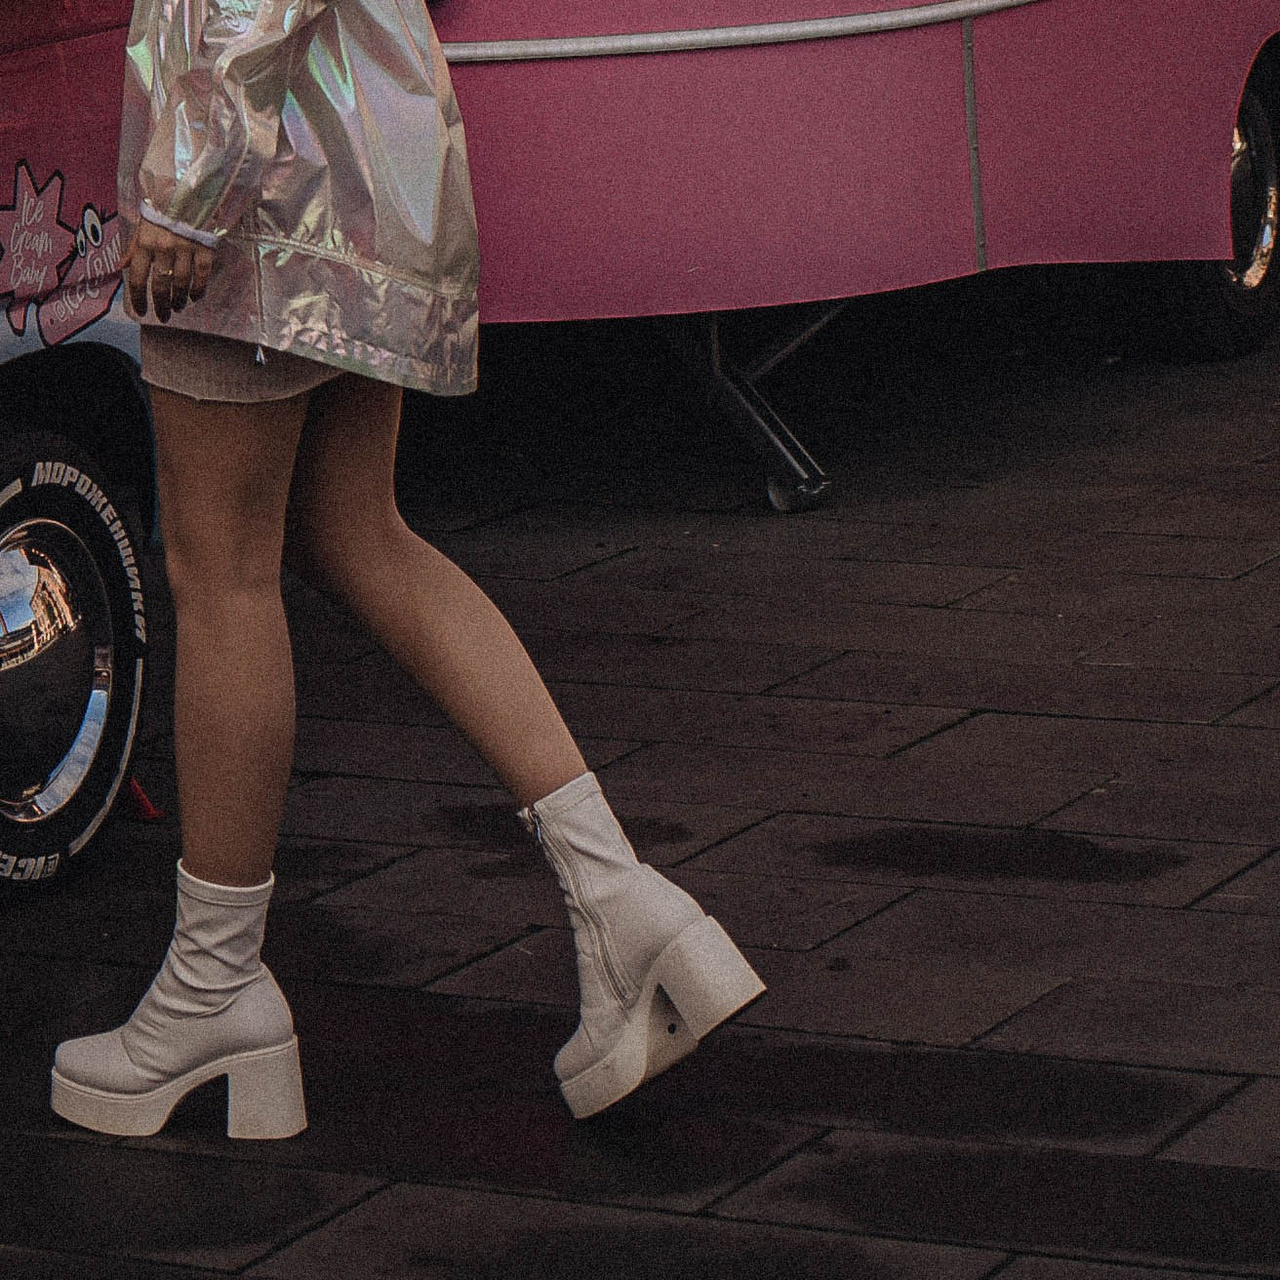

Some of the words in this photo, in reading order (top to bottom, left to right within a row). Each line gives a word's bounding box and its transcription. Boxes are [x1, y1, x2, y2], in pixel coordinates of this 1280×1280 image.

[21, 190, 45, 228] Ice
[9, 220, 54, 256] Cream
[9, 254, 48, 292] Baby
[30, 460, 149, 644] МОРОЖЕНЩИКИ
